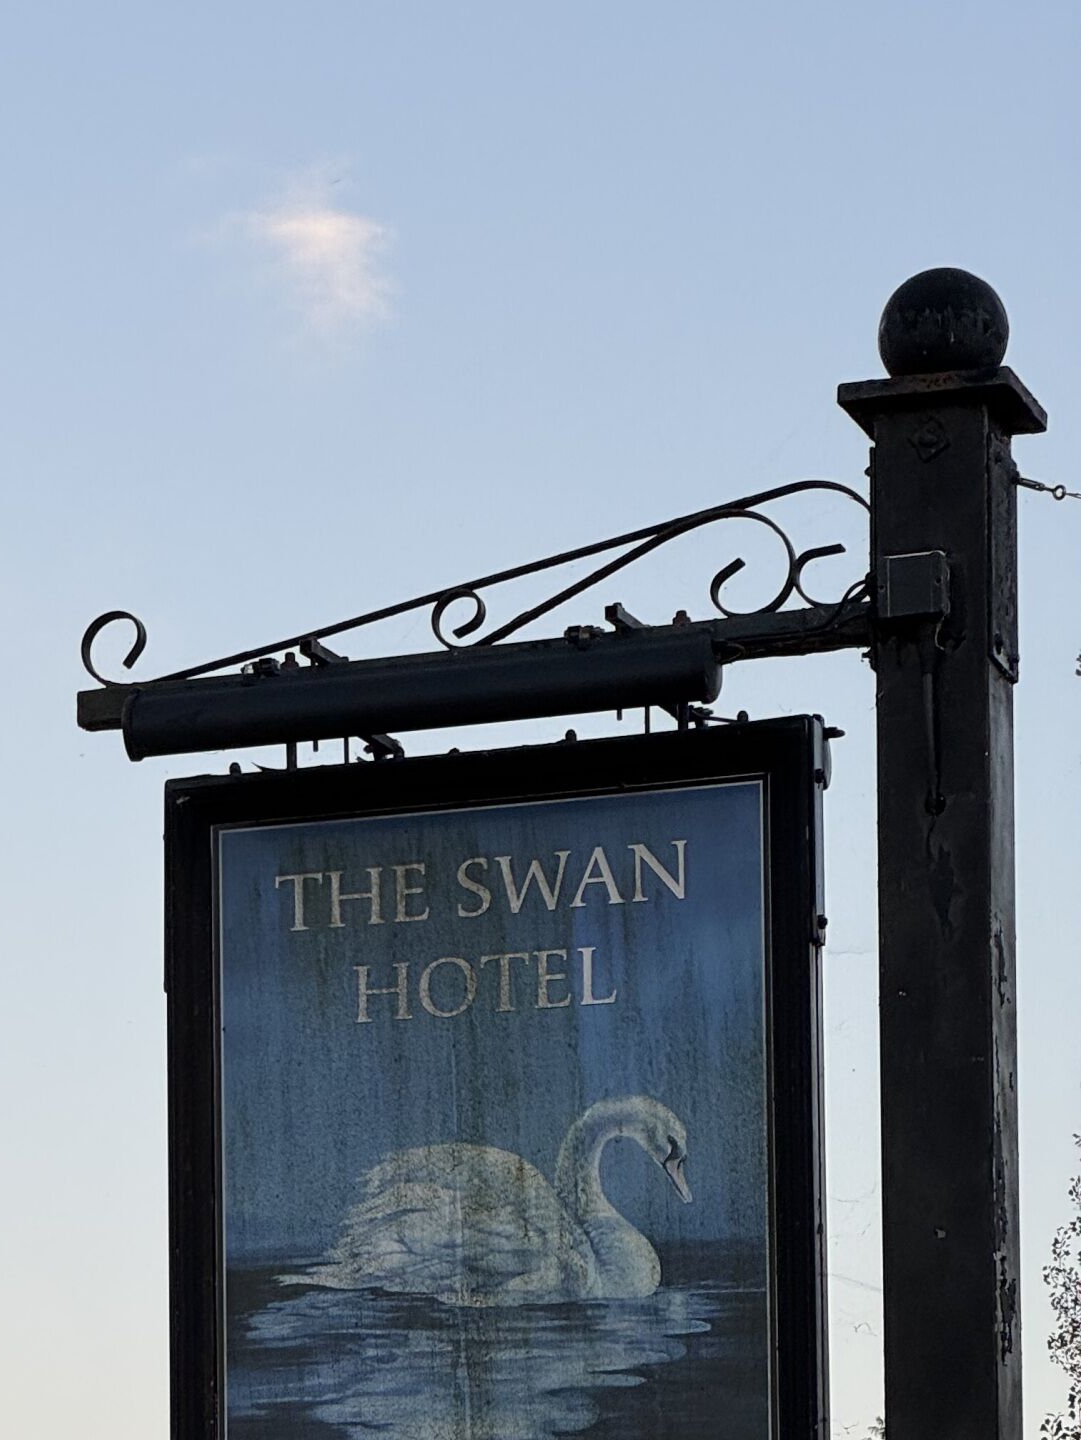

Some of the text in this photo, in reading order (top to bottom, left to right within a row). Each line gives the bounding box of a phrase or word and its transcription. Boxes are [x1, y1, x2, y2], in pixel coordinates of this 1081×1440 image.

[275, 839, 688, 932] THE SWAN
[353, 946, 618, 1023] HOTEL
